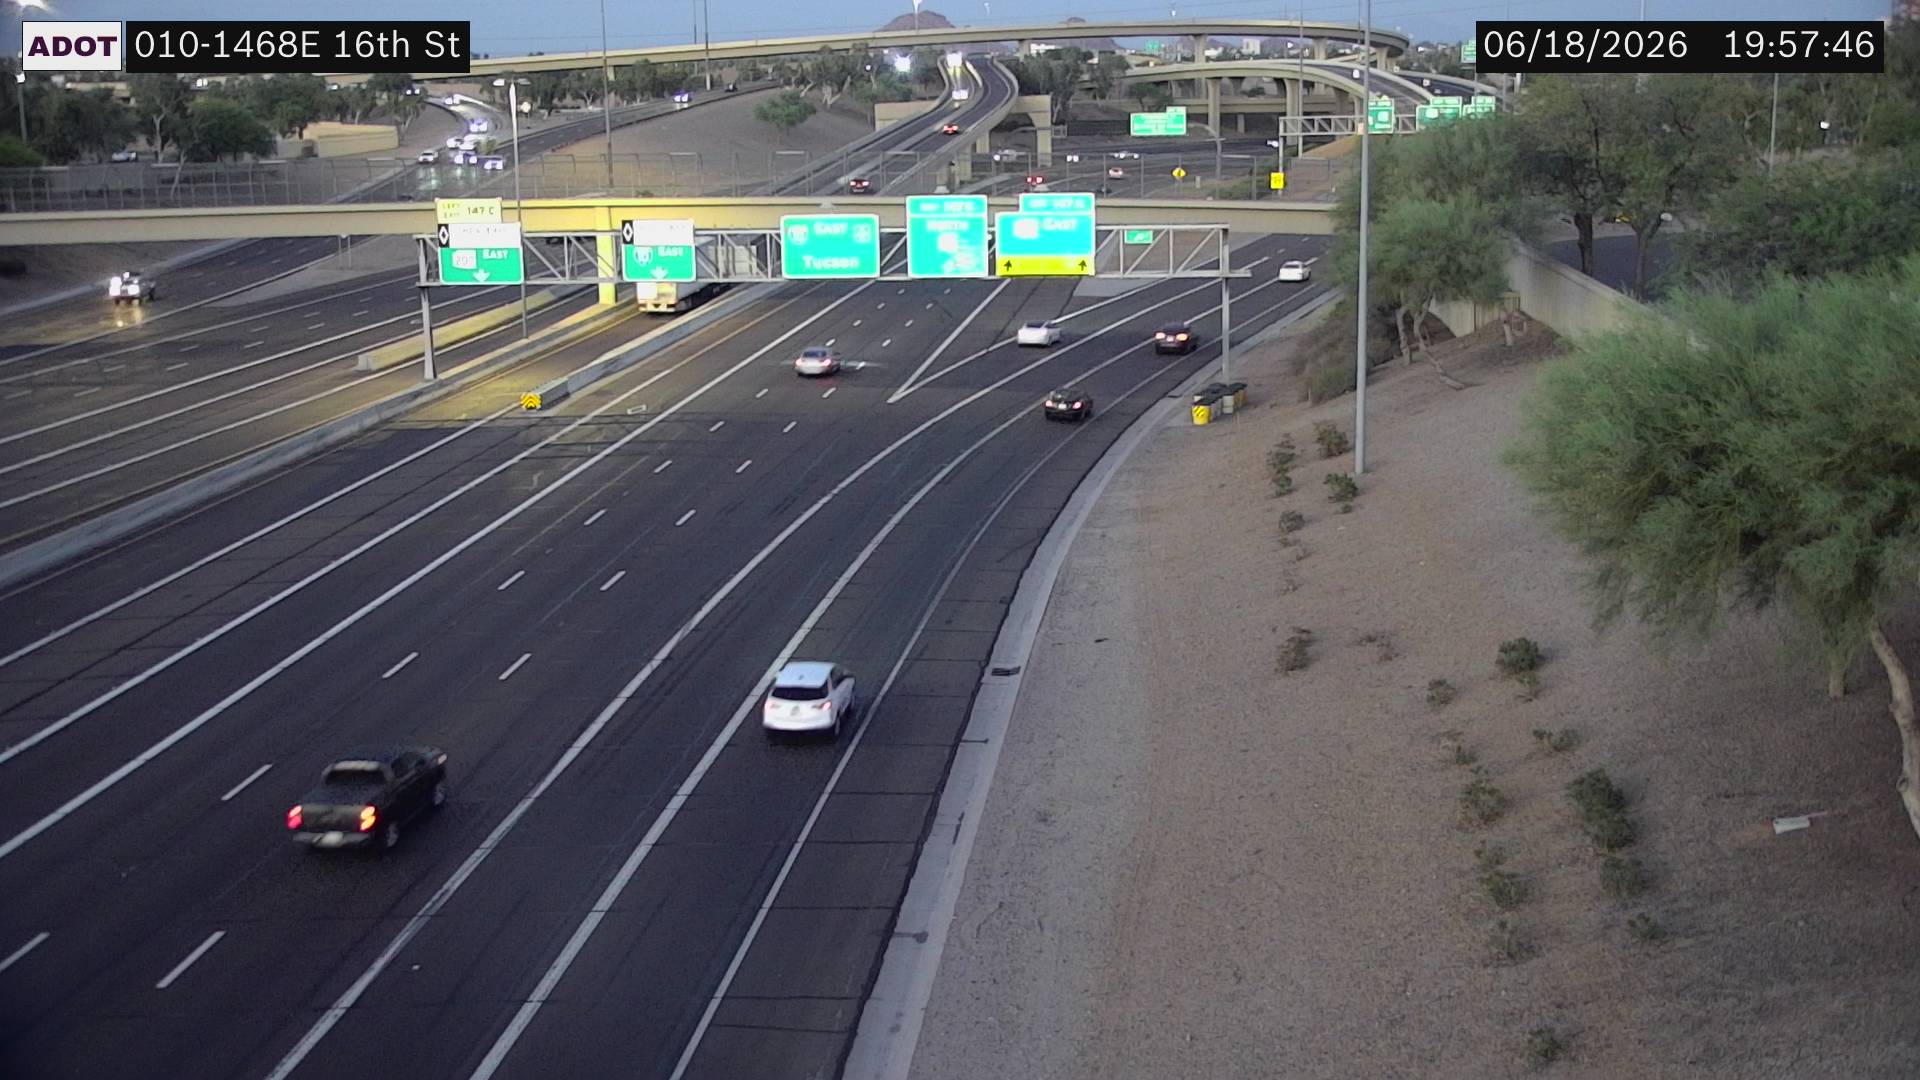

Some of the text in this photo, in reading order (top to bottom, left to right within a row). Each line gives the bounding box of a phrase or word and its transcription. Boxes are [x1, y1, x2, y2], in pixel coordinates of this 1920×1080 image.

[467, 206, 485, 215] 147
[482, 248, 509, 260] EAST
[657, 246, 684, 257] EAST
[802, 255, 859, 268] Tucson
